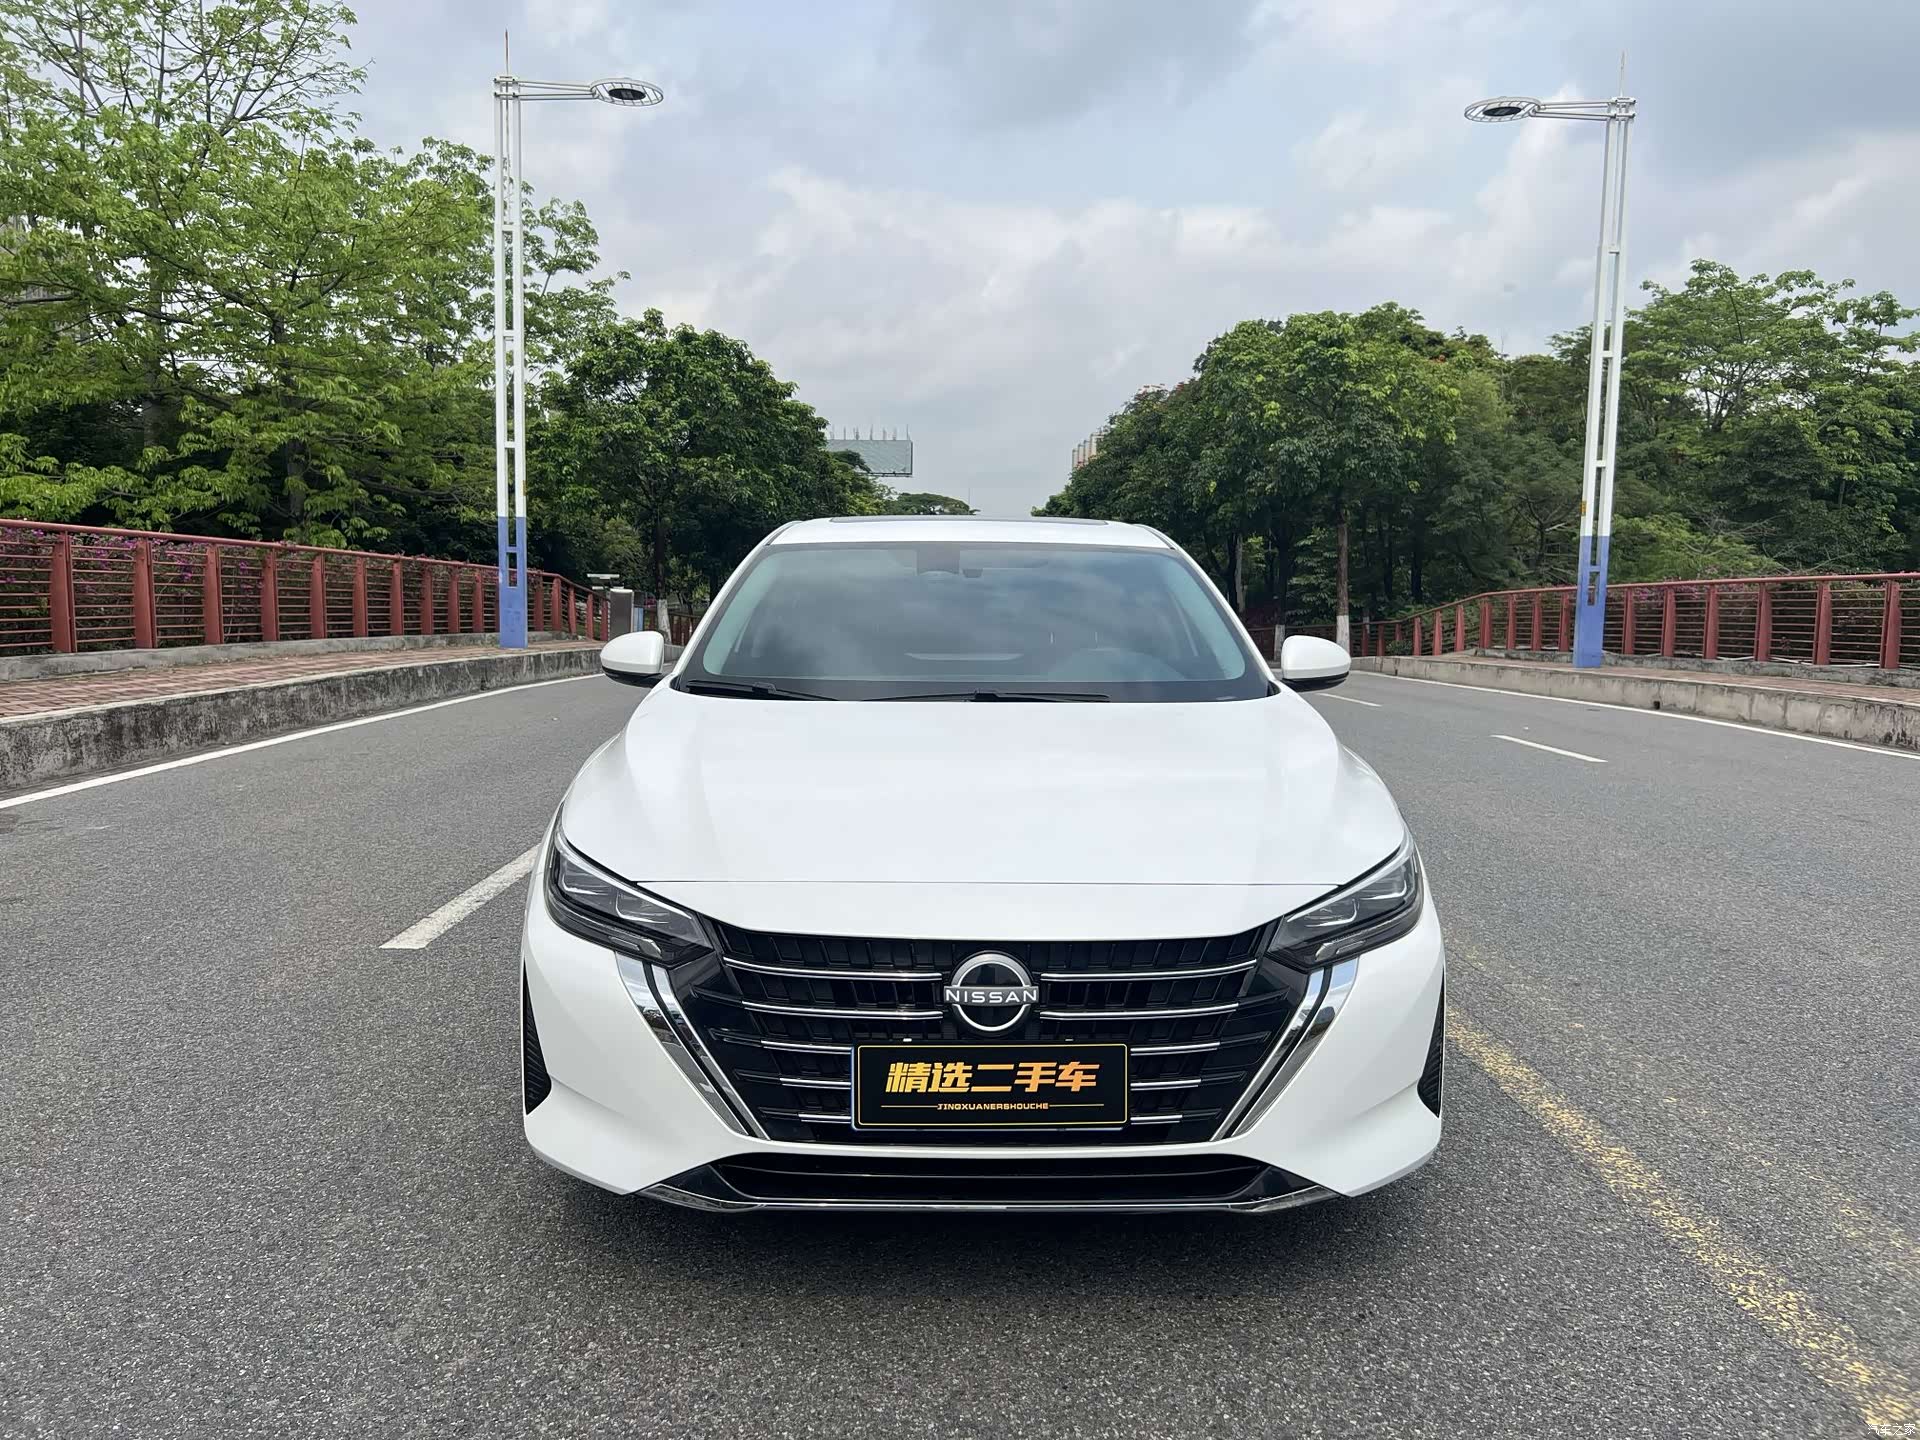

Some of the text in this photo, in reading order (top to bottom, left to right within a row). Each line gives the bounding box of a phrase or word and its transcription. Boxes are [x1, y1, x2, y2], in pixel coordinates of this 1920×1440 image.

[945, 989, 1037, 1004] NISSAN
[885, 1061, 1100, 1093] 精选二手车
[937, 1102, 1049, 1111] JINGXUANERSHOUCHE
